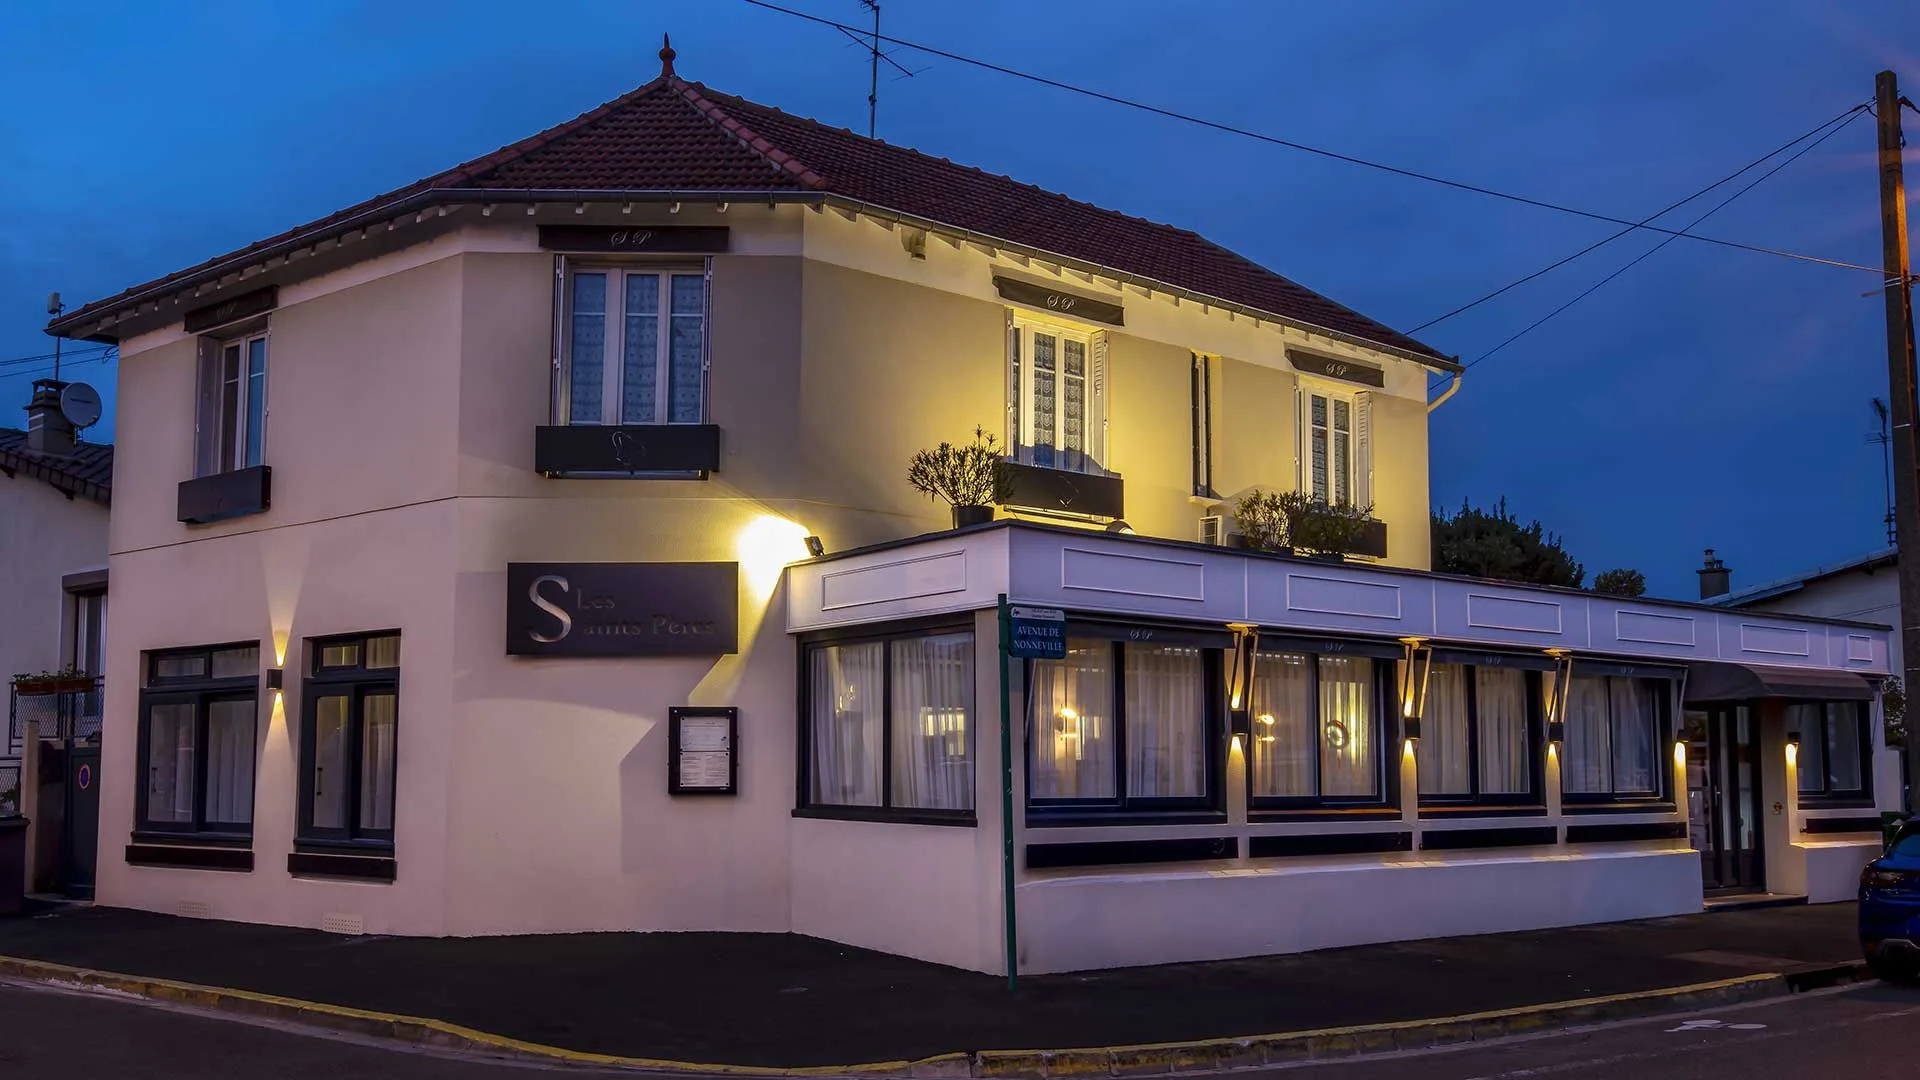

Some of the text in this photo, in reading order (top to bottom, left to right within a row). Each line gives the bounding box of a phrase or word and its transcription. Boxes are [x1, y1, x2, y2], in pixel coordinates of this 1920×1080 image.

[576, 588, 615, 609] Les
[1017, 626, 1060, 637] AVENUE DE
[1014, 639, 1064, 651] NONNEVILLE
